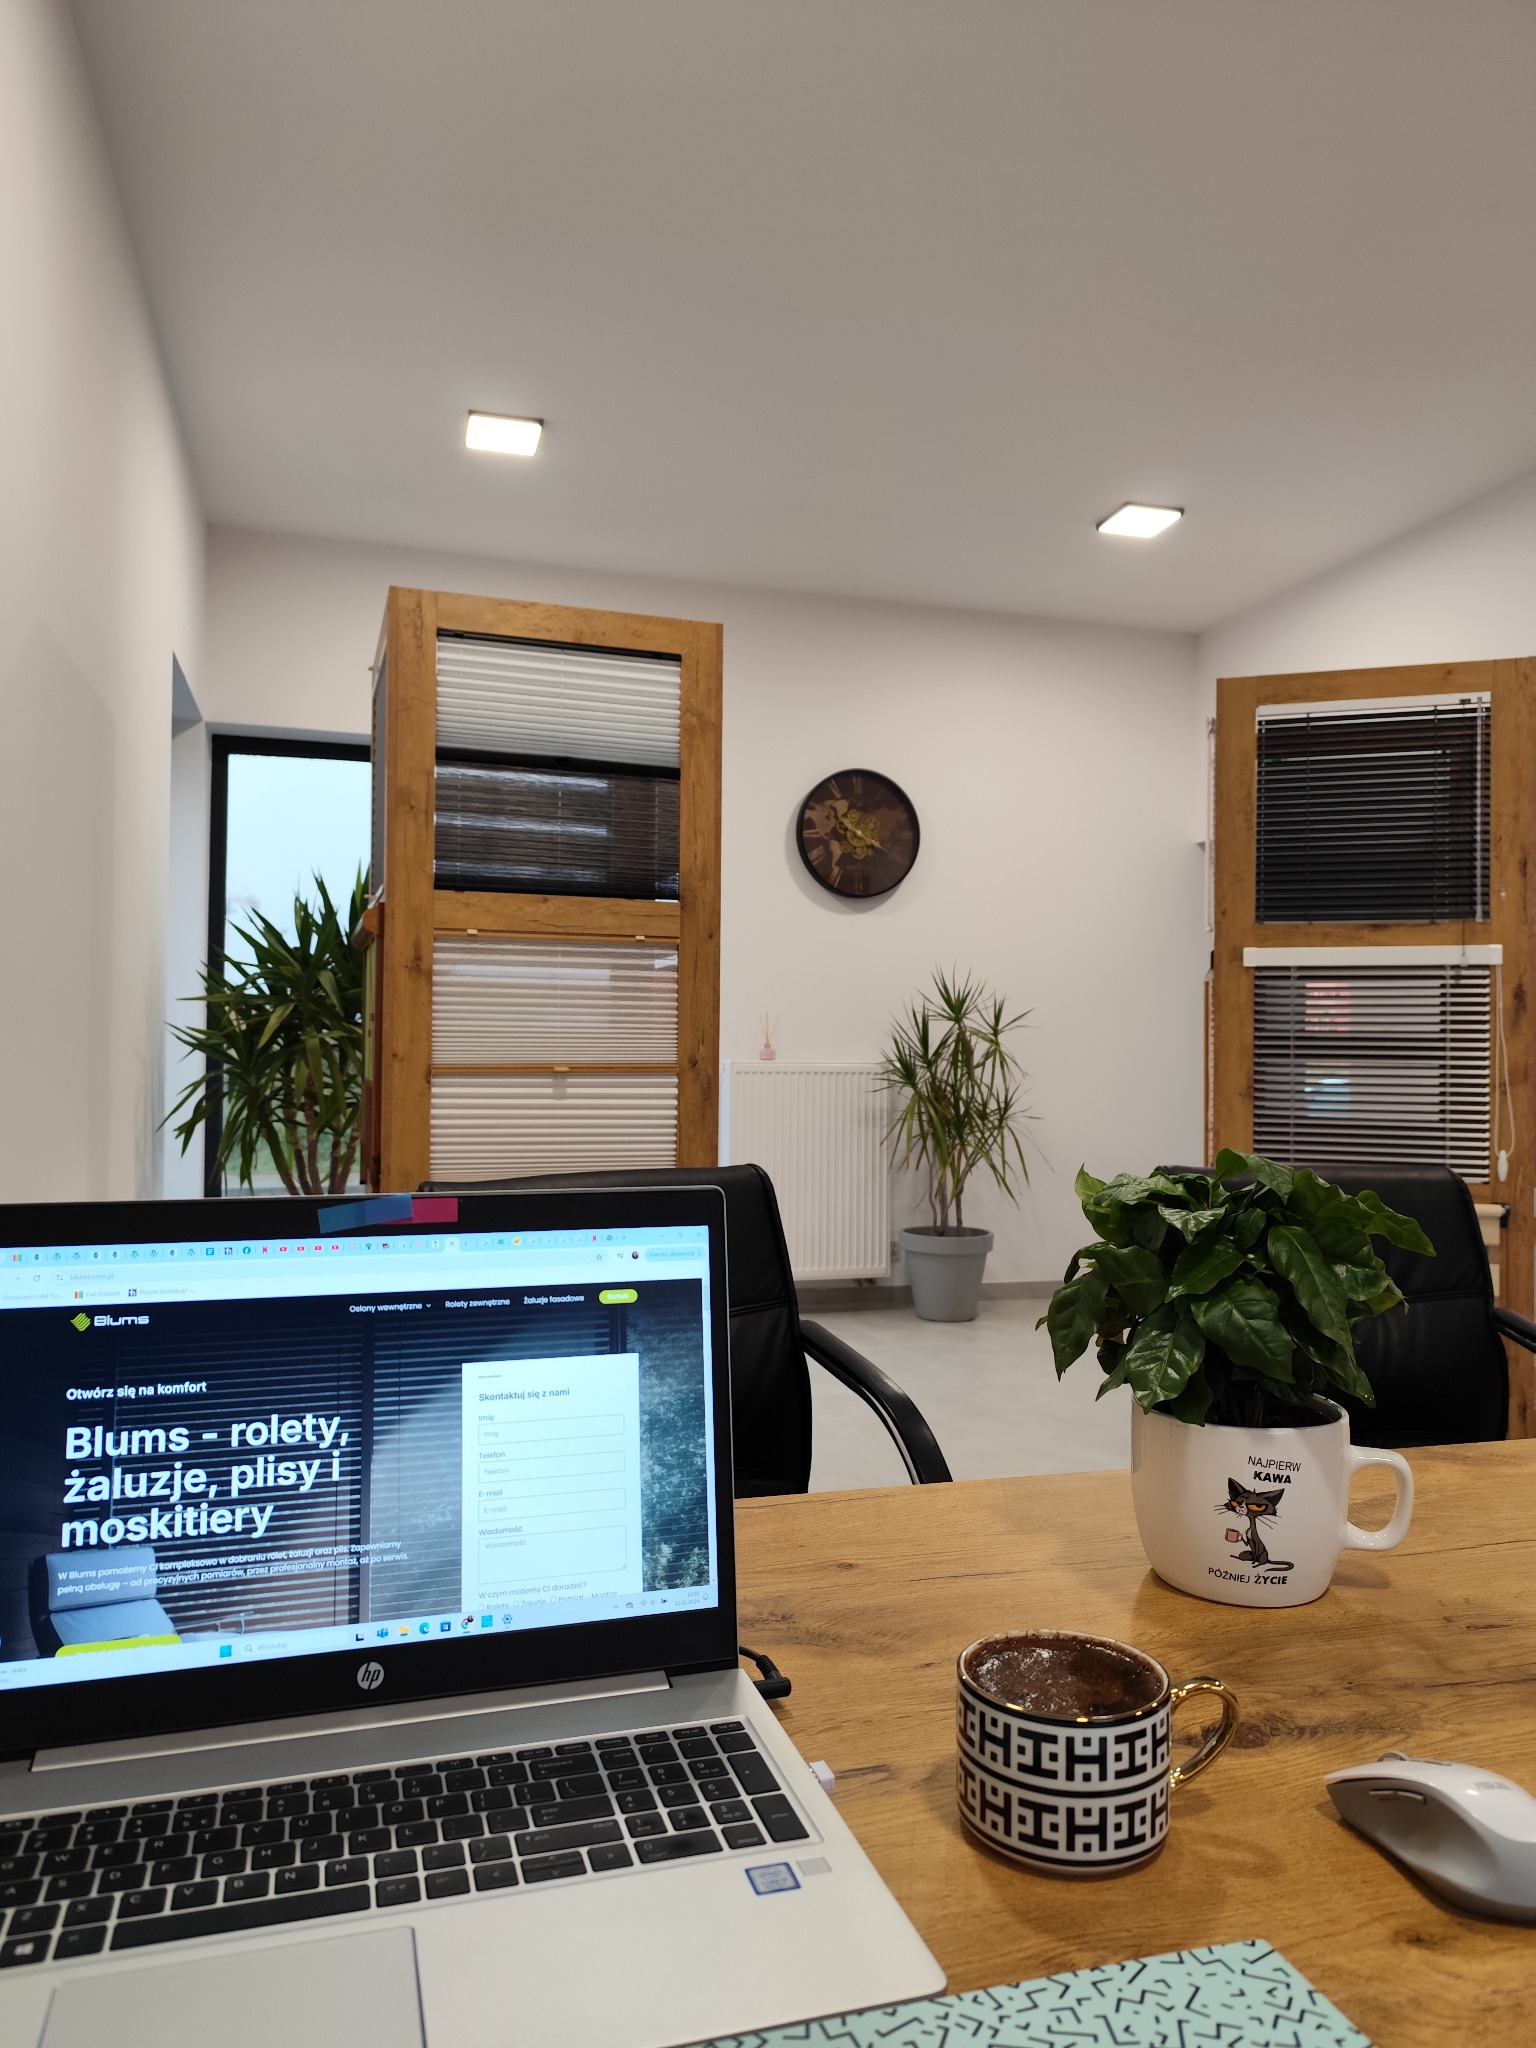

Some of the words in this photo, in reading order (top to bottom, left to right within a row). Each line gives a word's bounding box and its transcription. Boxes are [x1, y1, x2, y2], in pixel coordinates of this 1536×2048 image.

[70, 1272, 114, 1282] blums.com.pl
[445, 1300, 468, 1309] Rolety
[469, 1298, 510, 1307] zewnętrzne
[523, 1296, 548, 1305] Żaluzje
[549, 1294, 584, 1303] fasadowe
[377, 1302, 422, 1312] wewnętrzne
[94, 1314, 150, 1327] Blums
[66, 1386, 114, 1401] Otwórz
[116, 1385, 135, 1399] się
[138, 1385, 154, 1396] na
[157, 1381, 207, 1395] komfort
[478, 1390, 525, 1402] Skontaktuj
[527, 1389, 540, 1400] się
[549, 1387, 570, 1397] nami
[478, 1414, 494, 1422] Imię
[65, 1425, 190, 1460] Blums
[202, 1432, 218, 1440] -
[231, 1413, 349, 1449] rolety,
[483, 1430, 499, 1438] Imię
[478, 1451, 506, 1460] Telefon
[1247, 1455, 1302, 1473] NAJPIERW
[64, 1461, 217, 1504] żaluzje,
[231, 1454, 321, 1498] plisy
[331, 1449, 341, 1481] i
[484, 1467, 510, 1475] Telefon
[1252, 1470, 1292, 1484] KAWA
[478, 1489, 503, 1498] E-mail
[483, 1505, 507, 1513] E-mail
[61, 1502, 274, 1548] moskitiery
[478, 1525, 523, 1536] Wiadomość
[485, 1539, 527, 1549] Wiadomość
[57, 1571, 68, 1581] W
[68, 1569, 97, 1580] Blums
[97, 1565, 147, 1579] pomożemy
[158, 1557, 217, 1571] kompleksowo
[218, 1557, 227, 1565] w
[227, 1552, 266, 1564] dobraniu
[266, 1550, 288, 1561] rolet,
[288, 1547, 314, 1558] żaluzji
[314, 1548, 332, 1556] oraz
[350, 1540, 402, 1553] Zapewniamy
[57, 1584, 84, 1597] pełną
[84, 1581, 121, 1592] obsługę
[129, 1577, 142, 1587] od
[143, 1572, 200, 1587] precyzyjnych
[246, 1566, 269, 1576] przez
[269, 1560, 325, 1576] profesjonalny
[325, 1556, 359, 1568] montaż,
[359, 1555, 369, 1565] aż
[370, 1555, 381, 1565] po
[382, 1551, 409, 1562] serwis.
[1208, 1566, 1251, 1583] PÓŹNIEJ
[1253, 1572, 1288, 1585] ŻYCIE
[487, 1590, 508, 1600] czym
[509, 1586, 540, 1597] możemy
[542, 1585, 551, 1593] Ci
[551, 1580, 588, 1592] doradzić?
[257, 1641, 288, 1652] Wyszukaj
[359, 1661, 382, 1689] hp
